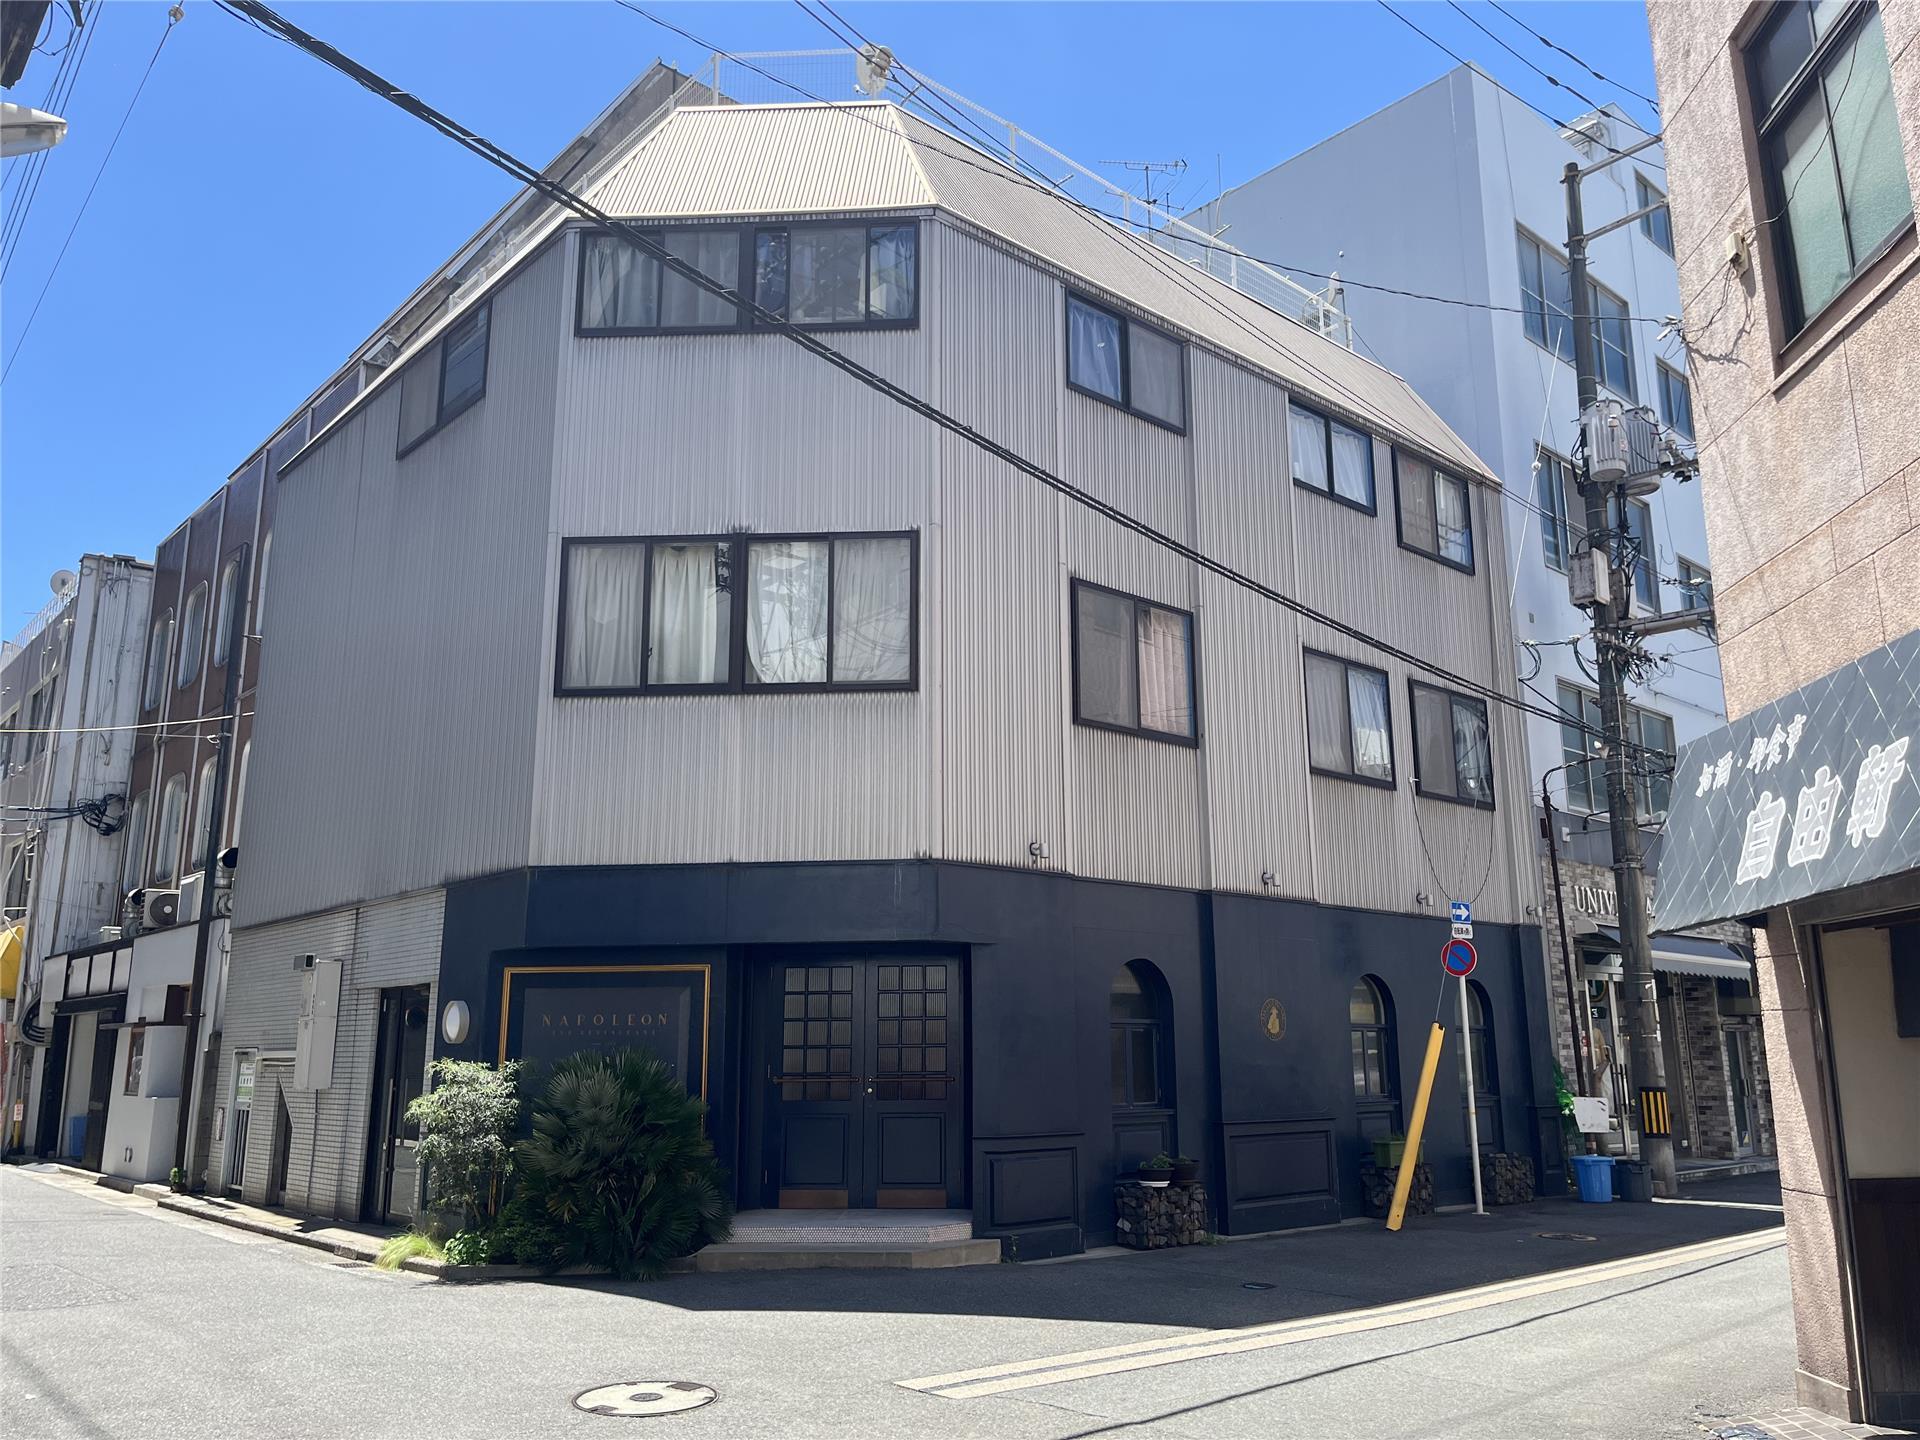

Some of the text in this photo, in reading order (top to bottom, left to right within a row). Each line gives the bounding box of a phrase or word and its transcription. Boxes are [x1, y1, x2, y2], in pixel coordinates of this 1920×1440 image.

[1737, 736, 1910, 885] 自由軒
[541, 1012, 669, 1027] NAPOLEON
